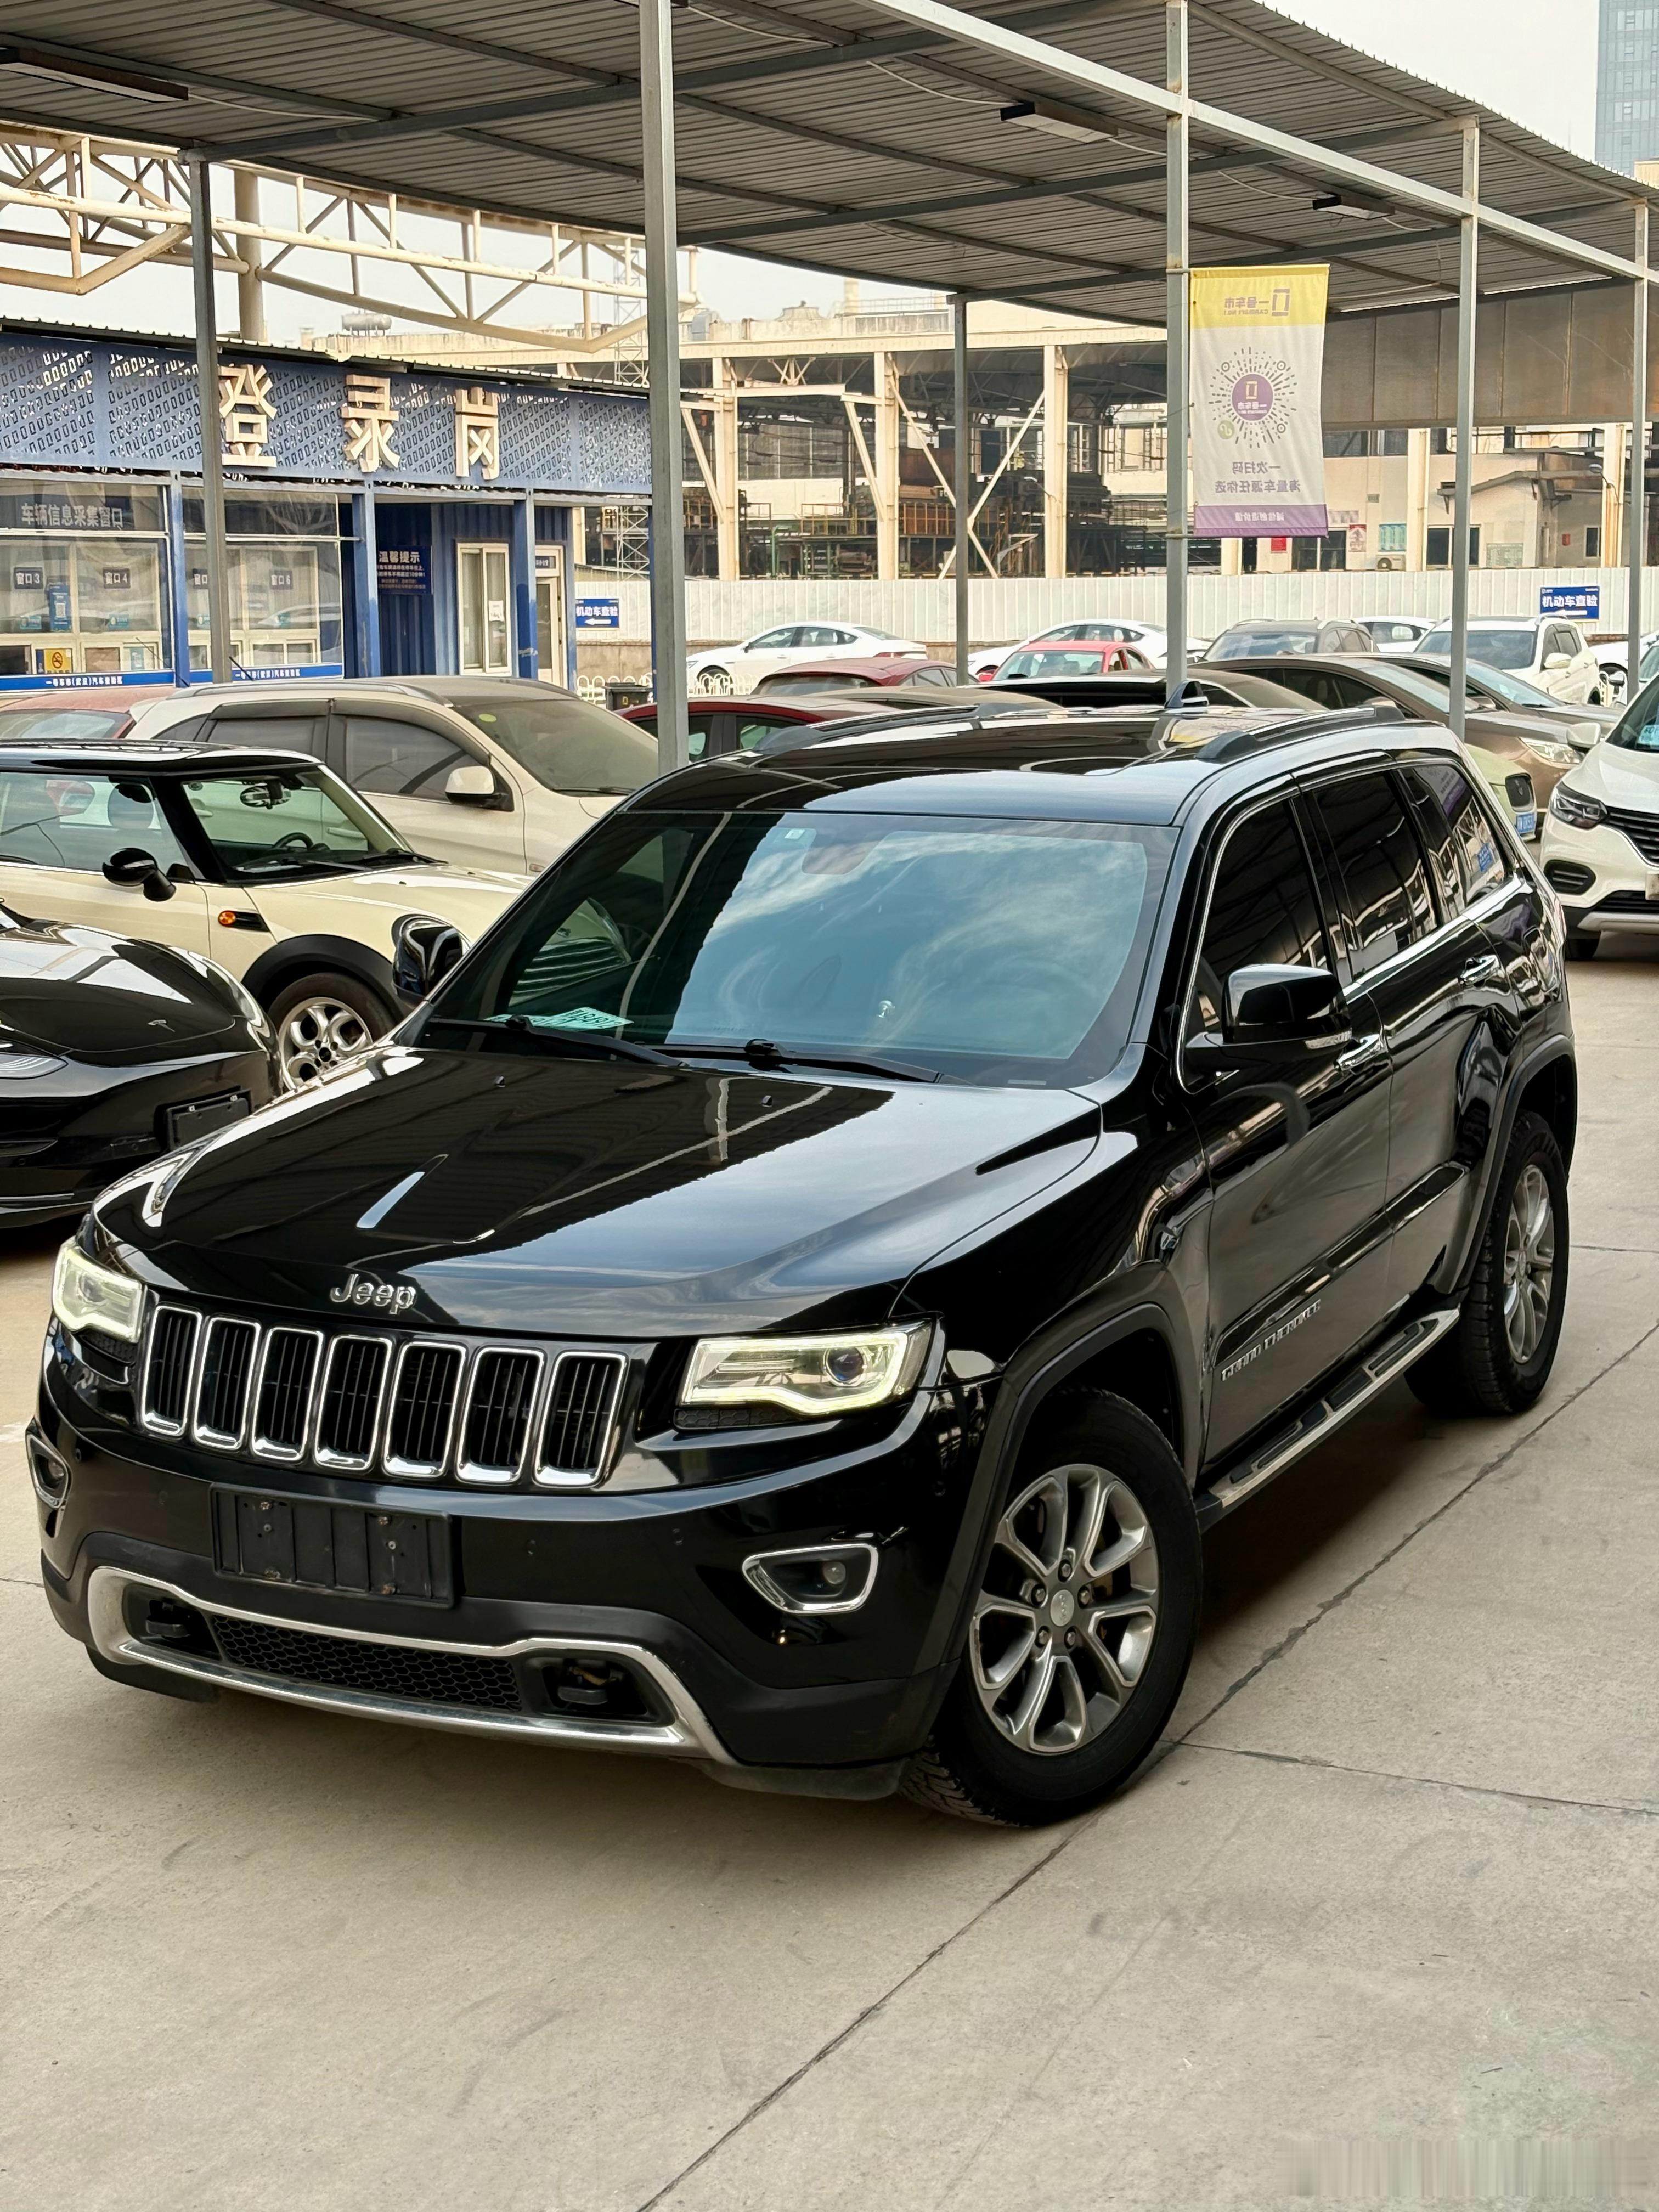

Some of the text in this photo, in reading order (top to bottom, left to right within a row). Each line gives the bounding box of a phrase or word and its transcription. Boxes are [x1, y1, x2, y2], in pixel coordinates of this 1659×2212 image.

[21, 503, 123, 528] 车辆信息采集窗口
[379, 551, 420, 563] 温馨提示
[1542, 595, 1598, 607] 机动车查验
[576, 606, 618, 616] 机动车查验
[330, 1274, 416, 1314] Jeep
